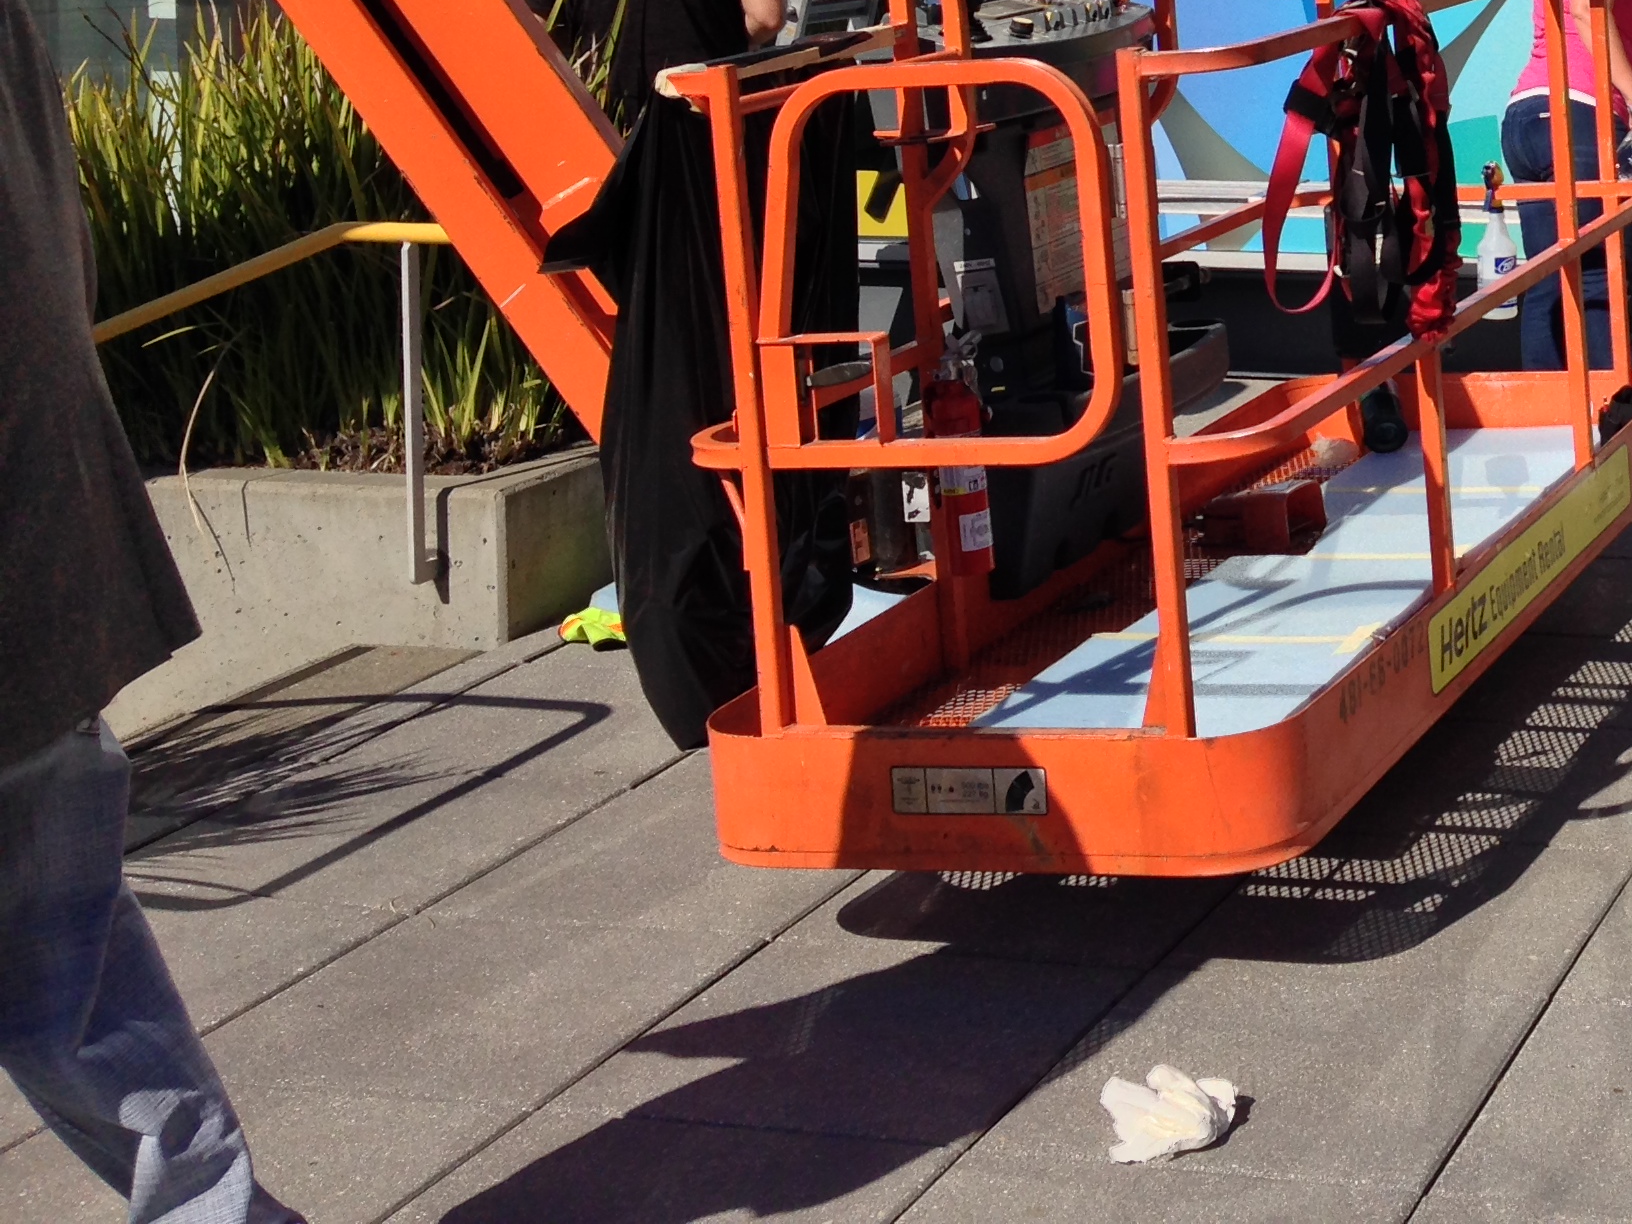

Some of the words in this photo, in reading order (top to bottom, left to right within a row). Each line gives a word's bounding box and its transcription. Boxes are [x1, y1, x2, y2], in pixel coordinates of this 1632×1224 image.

[1440, 593, 1488, 672] Hertz
[1489, 547, 1538, 621] Equipment
[1538, 520, 1566, 575] Rental
